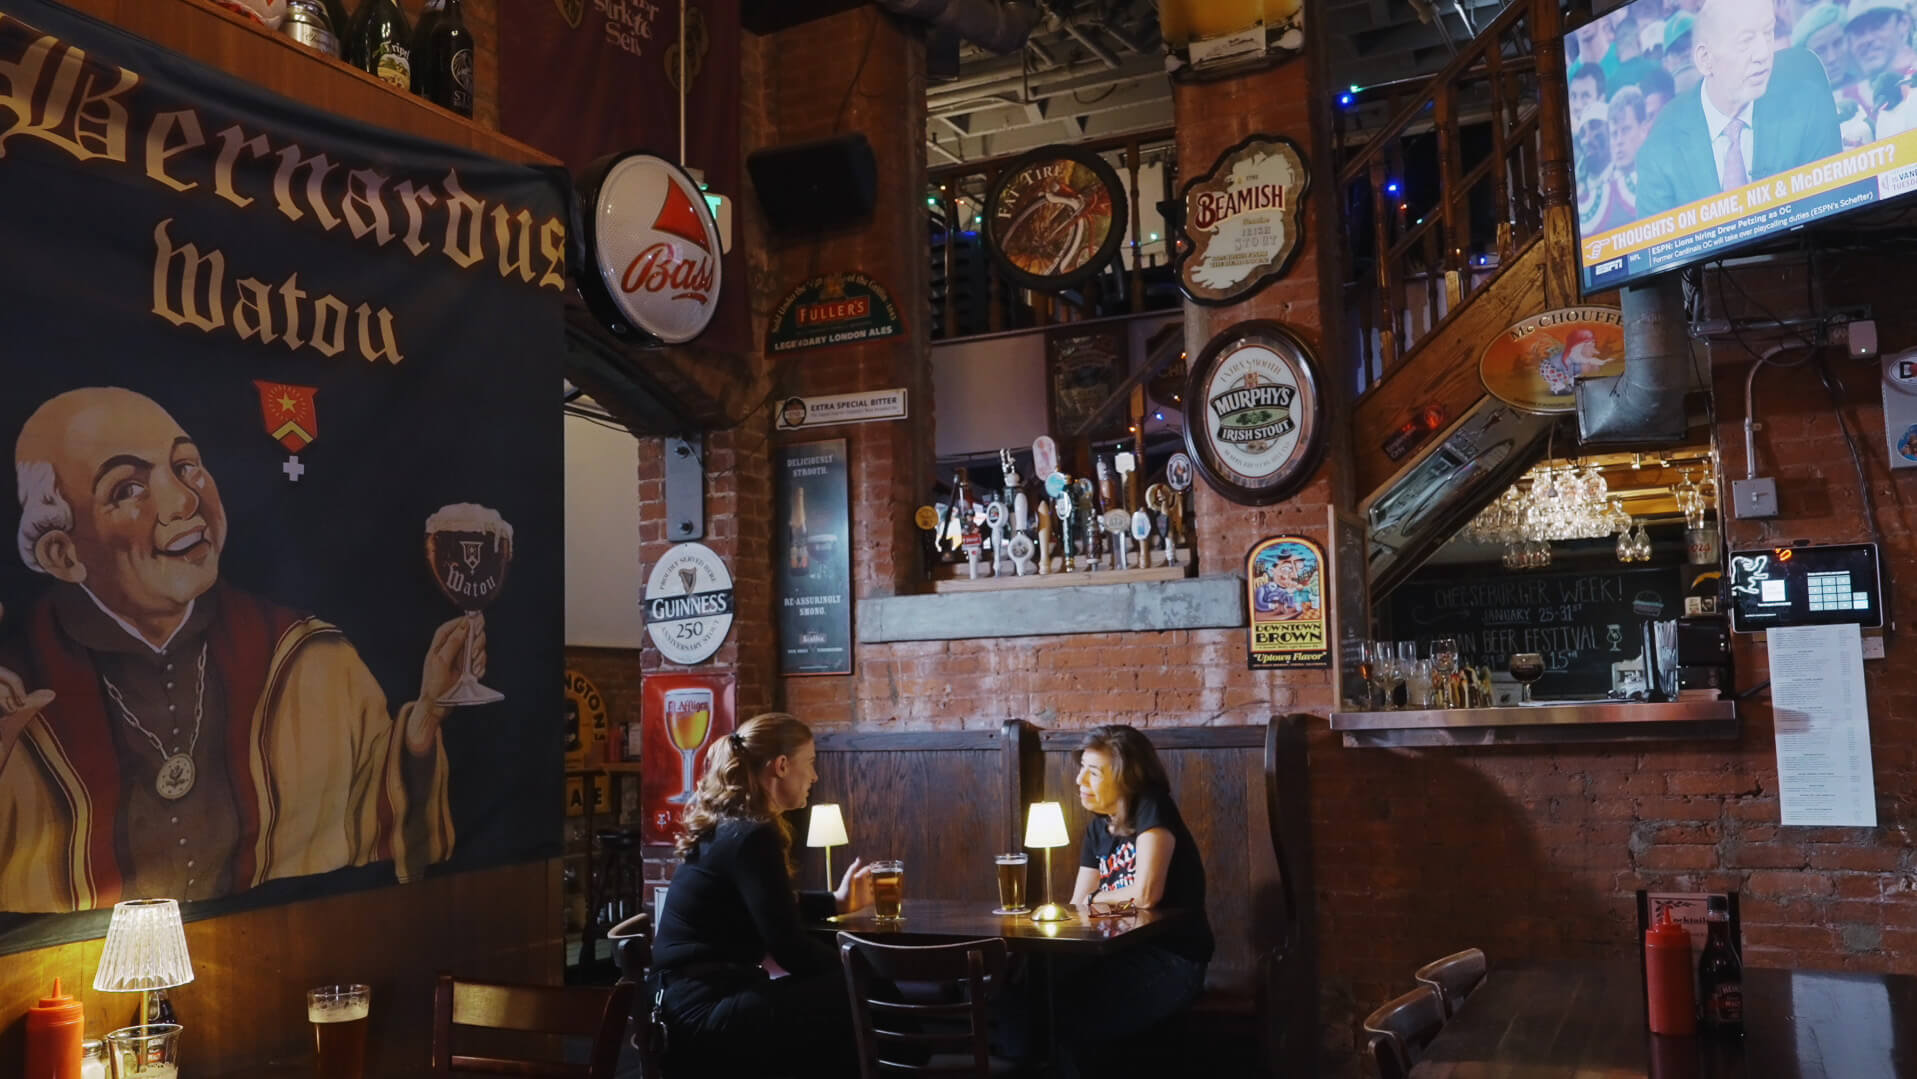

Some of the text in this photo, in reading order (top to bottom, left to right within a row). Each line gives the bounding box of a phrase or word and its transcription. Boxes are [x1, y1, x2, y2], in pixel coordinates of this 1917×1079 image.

[0, 34, 566, 292] Bernardus
[997, 165, 1063, 219] FAT TIRE
[1195, 184, 1283, 229] BEAMISH
[1611, 143, 1897, 251] THOUGHTS ON GAME, NIX & McDERMOTT?
[1651, 243, 1674, 255] ESPN:
[1675, 237, 1694, 248] Lions
[1695, 229, 1716, 242] hiring
[1718, 224, 1737, 235] Drew
[1737, 212, 1767, 230] Petzing
[1779, 205, 1792, 216] OC
[1653, 191, 1874, 265] Former Cardinals OC will take over playcalling duties (ESPN's Schefter)
[621, 242, 715, 293] Bass
[1595, 257, 1623, 276] ESPN
[151, 217, 404, 366] Watou
[799, 299, 866, 324] FULLER'S
[829, 329, 867, 343] LONDON
[868, 325, 894, 338] ALES
[1510, 324, 1536, 343] Mc
[810, 403, 834, 412] EXTRA
[837, 400, 868, 410] SPECIAL
[870, 396, 897, 406] BITTER
[1214, 385, 1294, 416] MURPHY'S
[1221, 421, 1290, 441] IRISH STOUT
[446, 561, 497, 598] Watou
[1433, 575, 1623, 608] CHEESEBURGER WEEK!
[651, 592, 728, 620] GUINNESS
[1482, 607, 1531, 621] JANUARY
[676, 621, 704, 640] 250
[1255, 623, 1321, 633] DOWNTOWN
[1255, 631, 1322, 644] BROWN
[1481, 628, 1519, 654] BEER
[1523, 624, 1601, 652] FESTIVAL
